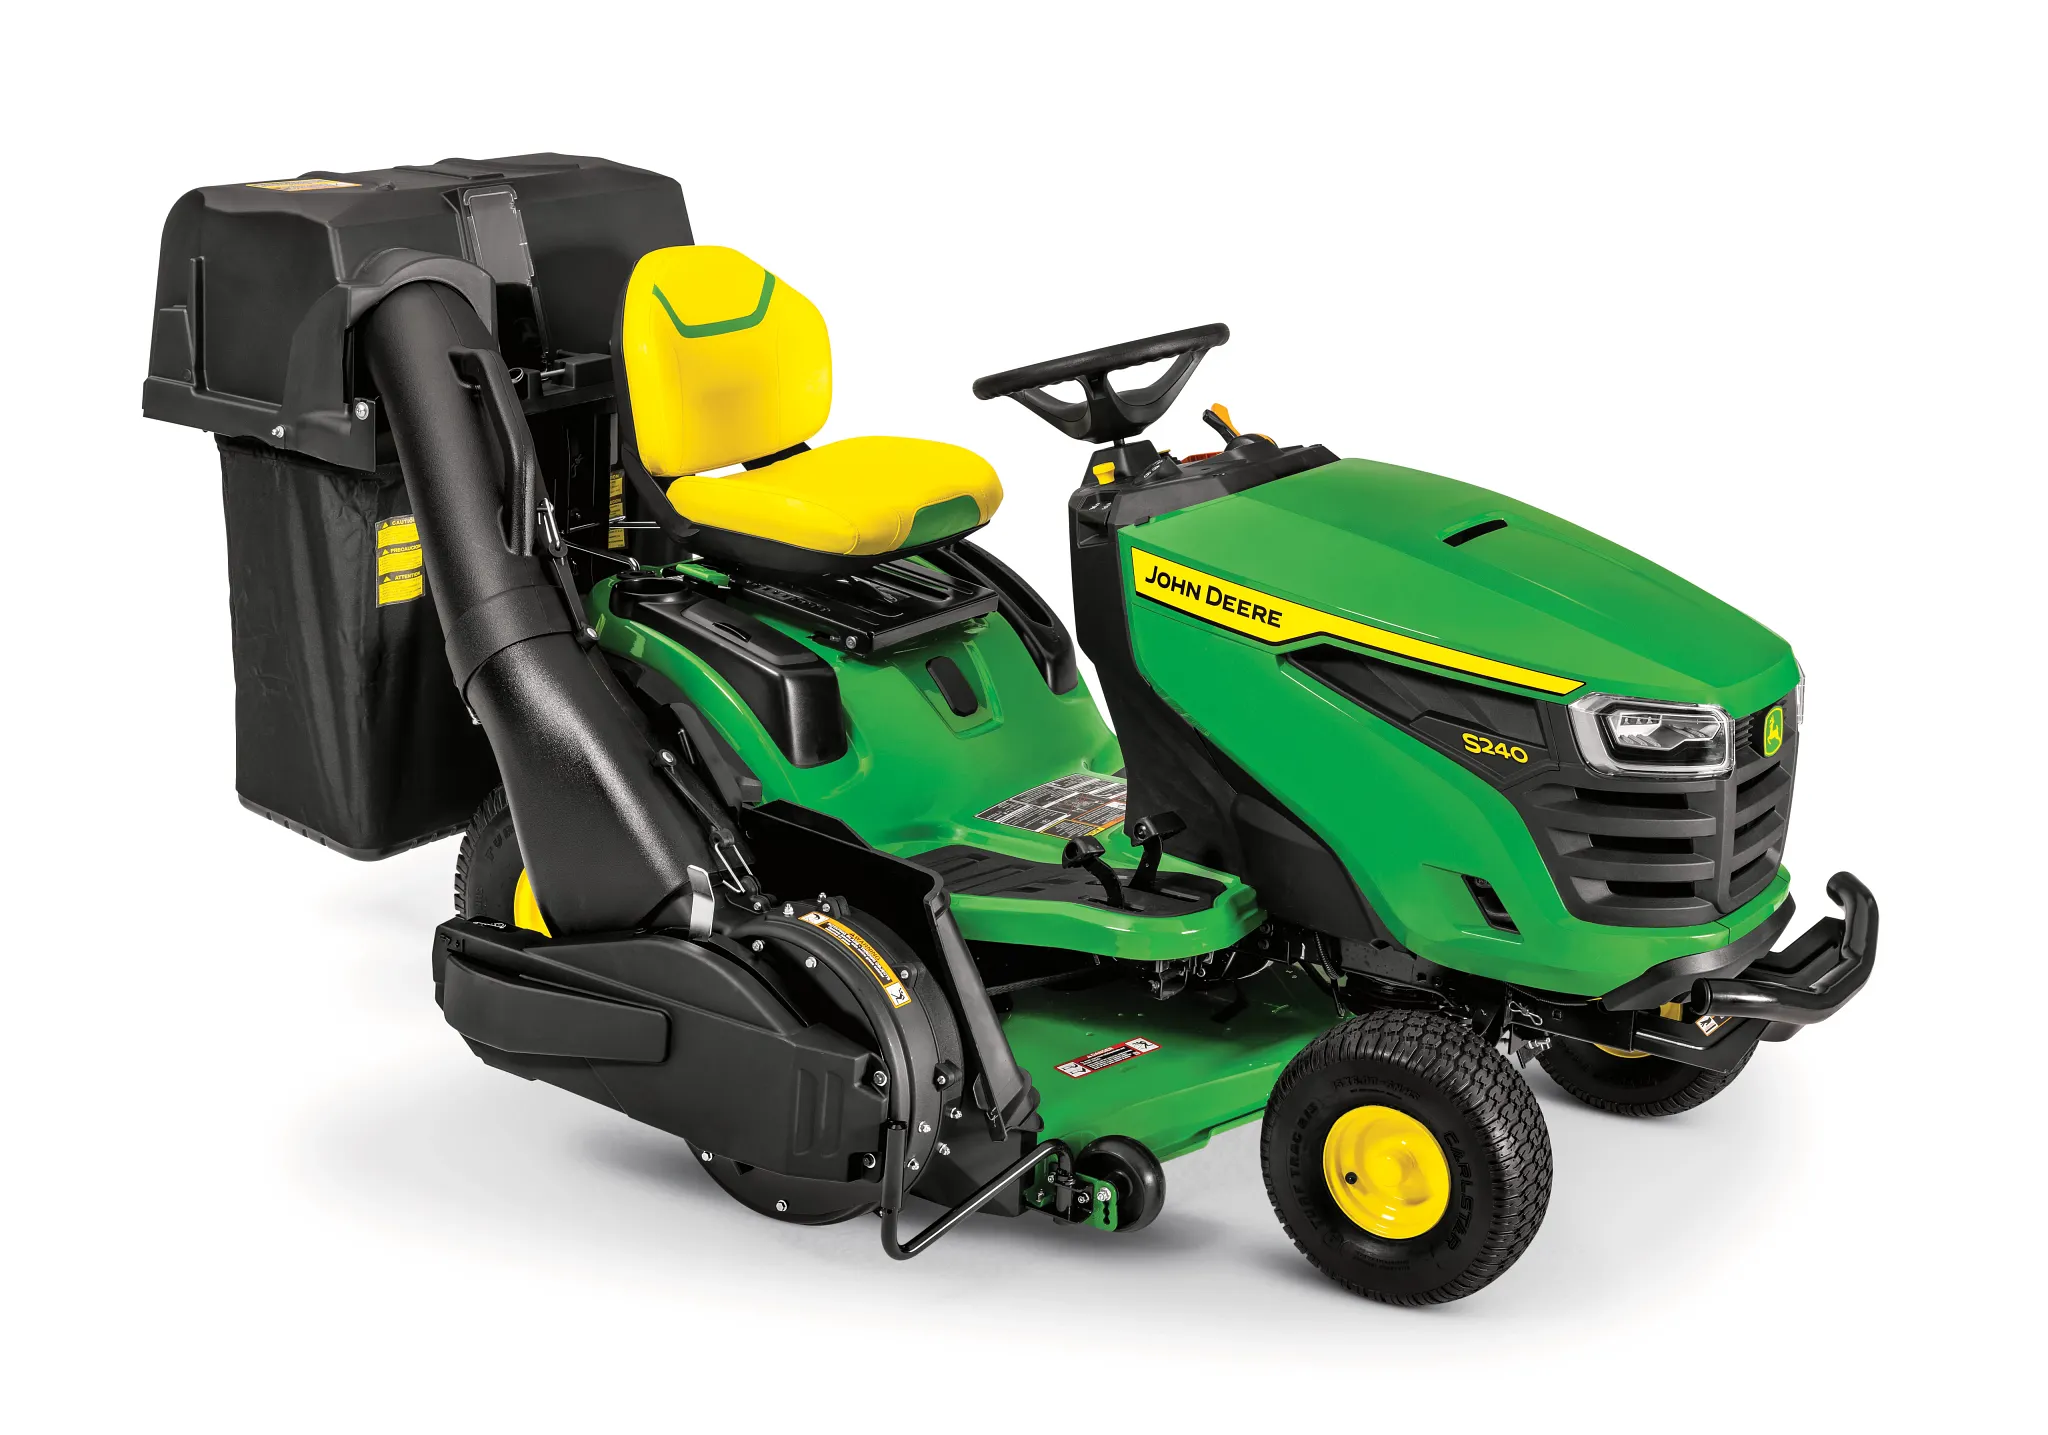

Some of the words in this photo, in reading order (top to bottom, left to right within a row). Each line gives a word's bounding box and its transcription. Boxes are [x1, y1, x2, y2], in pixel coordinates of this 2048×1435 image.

[1145, 565, 1201, 600] JOHN
[1205, 585, 1283, 628] DEERE
[1462, 733, 1529, 763] S240
[1290, 1131, 1303, 1179] TRAC
[1443, 1130, 1474, 1250] CARLSTAR
